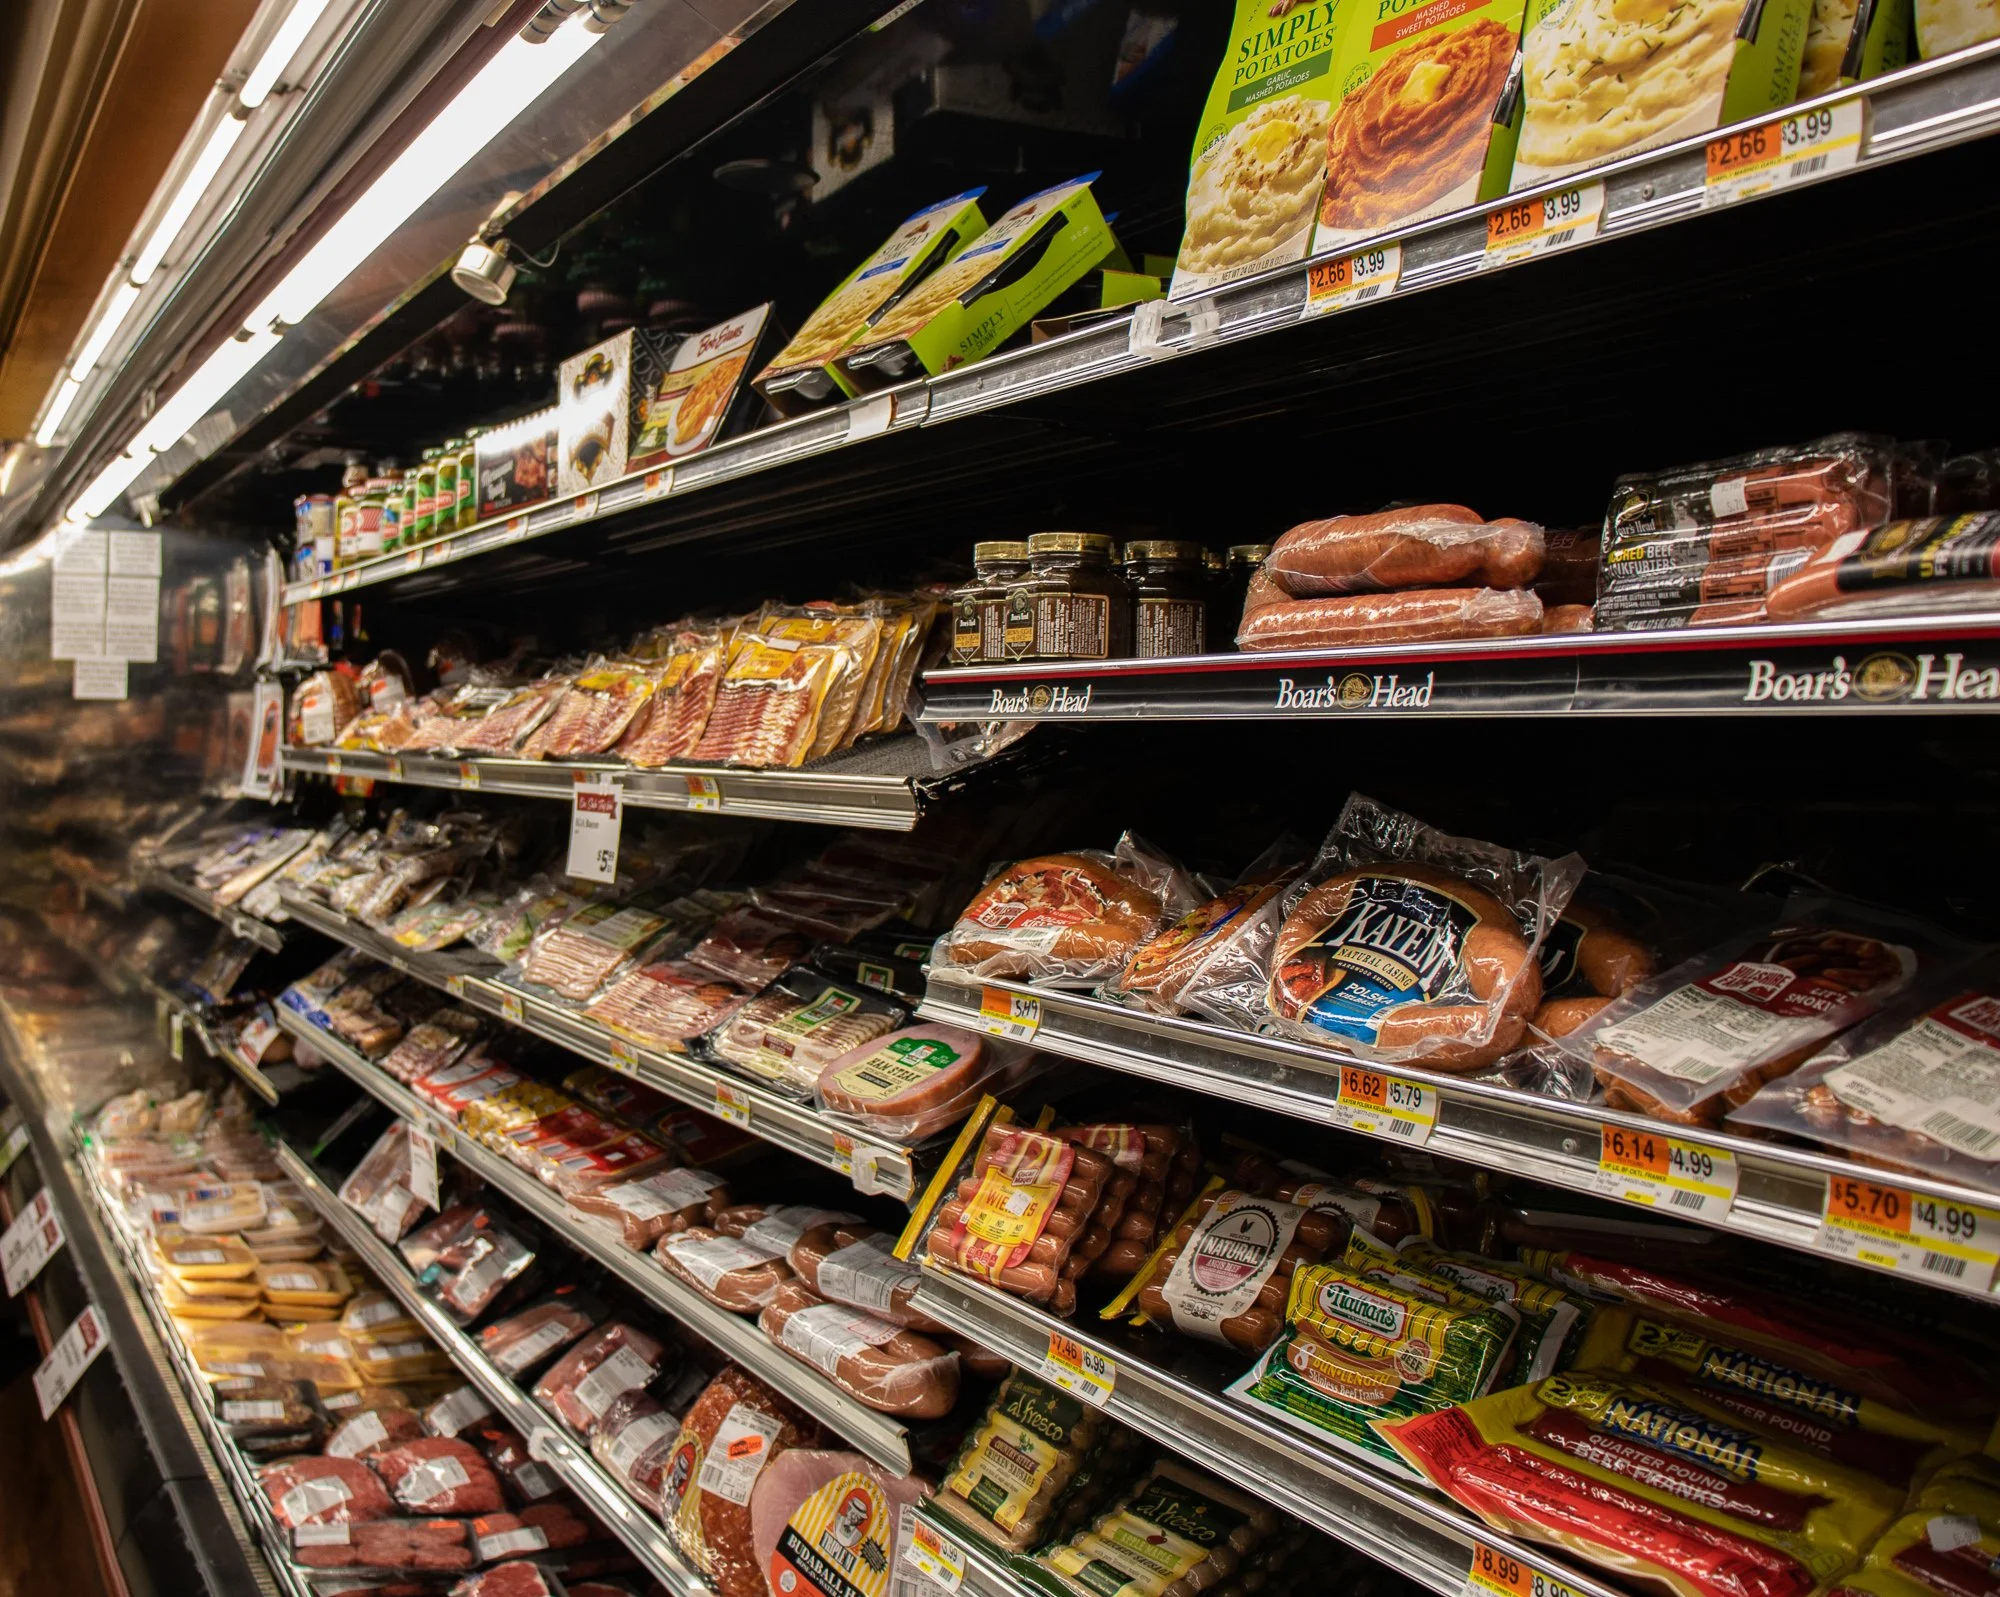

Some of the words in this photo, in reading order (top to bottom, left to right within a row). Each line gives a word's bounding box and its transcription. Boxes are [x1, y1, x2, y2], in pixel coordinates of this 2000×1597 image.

[1396, 21, 1421, 38] SWEET
[1425, 3, 1466, 27] POTATOES
[1415, 1, 1450, 21] MASHED
[1237, 0, 1339, 64] SIMPLY
[1233, 28, 1334, 86] POTATOES
[1244, 86, 1273, 104] MASHED
[1275, 71, 1310, 91] POTATOES
[1267, 69, 1292, 86] GARLIC
[1710, 127, 1766, 165] $2.66
[1782, 109, 1832, 145] $3.99
[1489, 205, 1531, 235] $2.66
[1543, 190, 1580, 220] $3.99
[1310, 261, 1345, 288] $2.66
[1353, 250, 1385, 276] $3.99
[960, 307, 1005, 351] SIMPLY
[1646, 544, 1673, 559] BEEF
[1275, 675, 1336, 709] Boar's
[1368, 672, 1435, 708] Head
[1744, 656, 1851, 701] Boar's
[988, 687, 1030, 713] Boar's
[1048, 684, 1092, 712] Head
[1338, 949, 1383, 968] NATURAL
[1382, 963, 1413, 987] CASING
[1338, 962, 1372, 978] HARDWOOD
[1373, 975, 1394, 990] SMOKED
[1719, 975, 1755, 993] FARM
[1736, 965, 1790, 988] HILLSHIRE
[1344, 982, 1394, 1005] POLSKA
[866, 1057, 892, 1070] HAM
[889, 1066, 922, 1082] STEAK
[1344, 1072, 1380, 1097] $6.62
[1389, 1082, 1421, 1108] $5.79
[1356, 1101, 1372, 1109] POLSKA
[1372, 1105, 1393, 1114] KIELBASA
[1605, 1133, 1655, 1163] $6.14
[1669, 1147, 1712, 1177] $4.99
[1835, 1181, 1899, 1219] $5.70
[1917, 1201, 1976, 1238] $4.99
[1203, 1236, 1261, 1265] NATURAL
[1351, 1236, 1367, 1251] NO
[1206, 1258, 1225, 1270] ANGUS
[1225, 1261, 1241, 1273] BEEF
[1327, 1285, 1396, 1327] Nathan's
[1052, 1334, 1077, 1359] $7.46
[1083, 1351, 1105, 1374] $6.99
[1294, 1344, 1316, 1371] 8
[1401, 1350, 1422, 1372] BEEF
[1308, 1368, 1338, 1393] Skinless
[1340, 1383, 1358, 1398] Beef
[1358, 1388, 1385, 1400] Franks
[1701, 1352, 1855, 1425] NATIONAL
[1008, 1393, 1026, 1417] al
[1021, 1399, 1063, 1440] fresco
[1769, 1412, 1832, 1443] POUND
[992, 1439, 1018, 1459] COUNTRY
[1015, 1453, 1035, 1470] STYLE
[1605, 1401, 1762, 1479] NATIONAL
[981, 1447, 1011, 1469] CHICKEN
[1006, 1463, 1038, 1487] SAUSAGE
[1574, 1441, 1631, 1472] BEEF
[1633, 1467, 1726, 1509] FRANKS
[1588, 1435, 1668, 1468] QUARTER
[1668, 1463, 1728, 1492] POUND
[1137, 1497, 1166, 1516] al
[1155, 1503, 1216, 1540] fresco
[787, 1534, 843, 1593] BUDABALL
[822, 1532, 847, 1563] TRIPLE
[847, 1554, 856, 1571] M
[1133, 1553, 1172, 1578] SAUSAGE
[1476, 1547, 1519, 1584] $8.99
